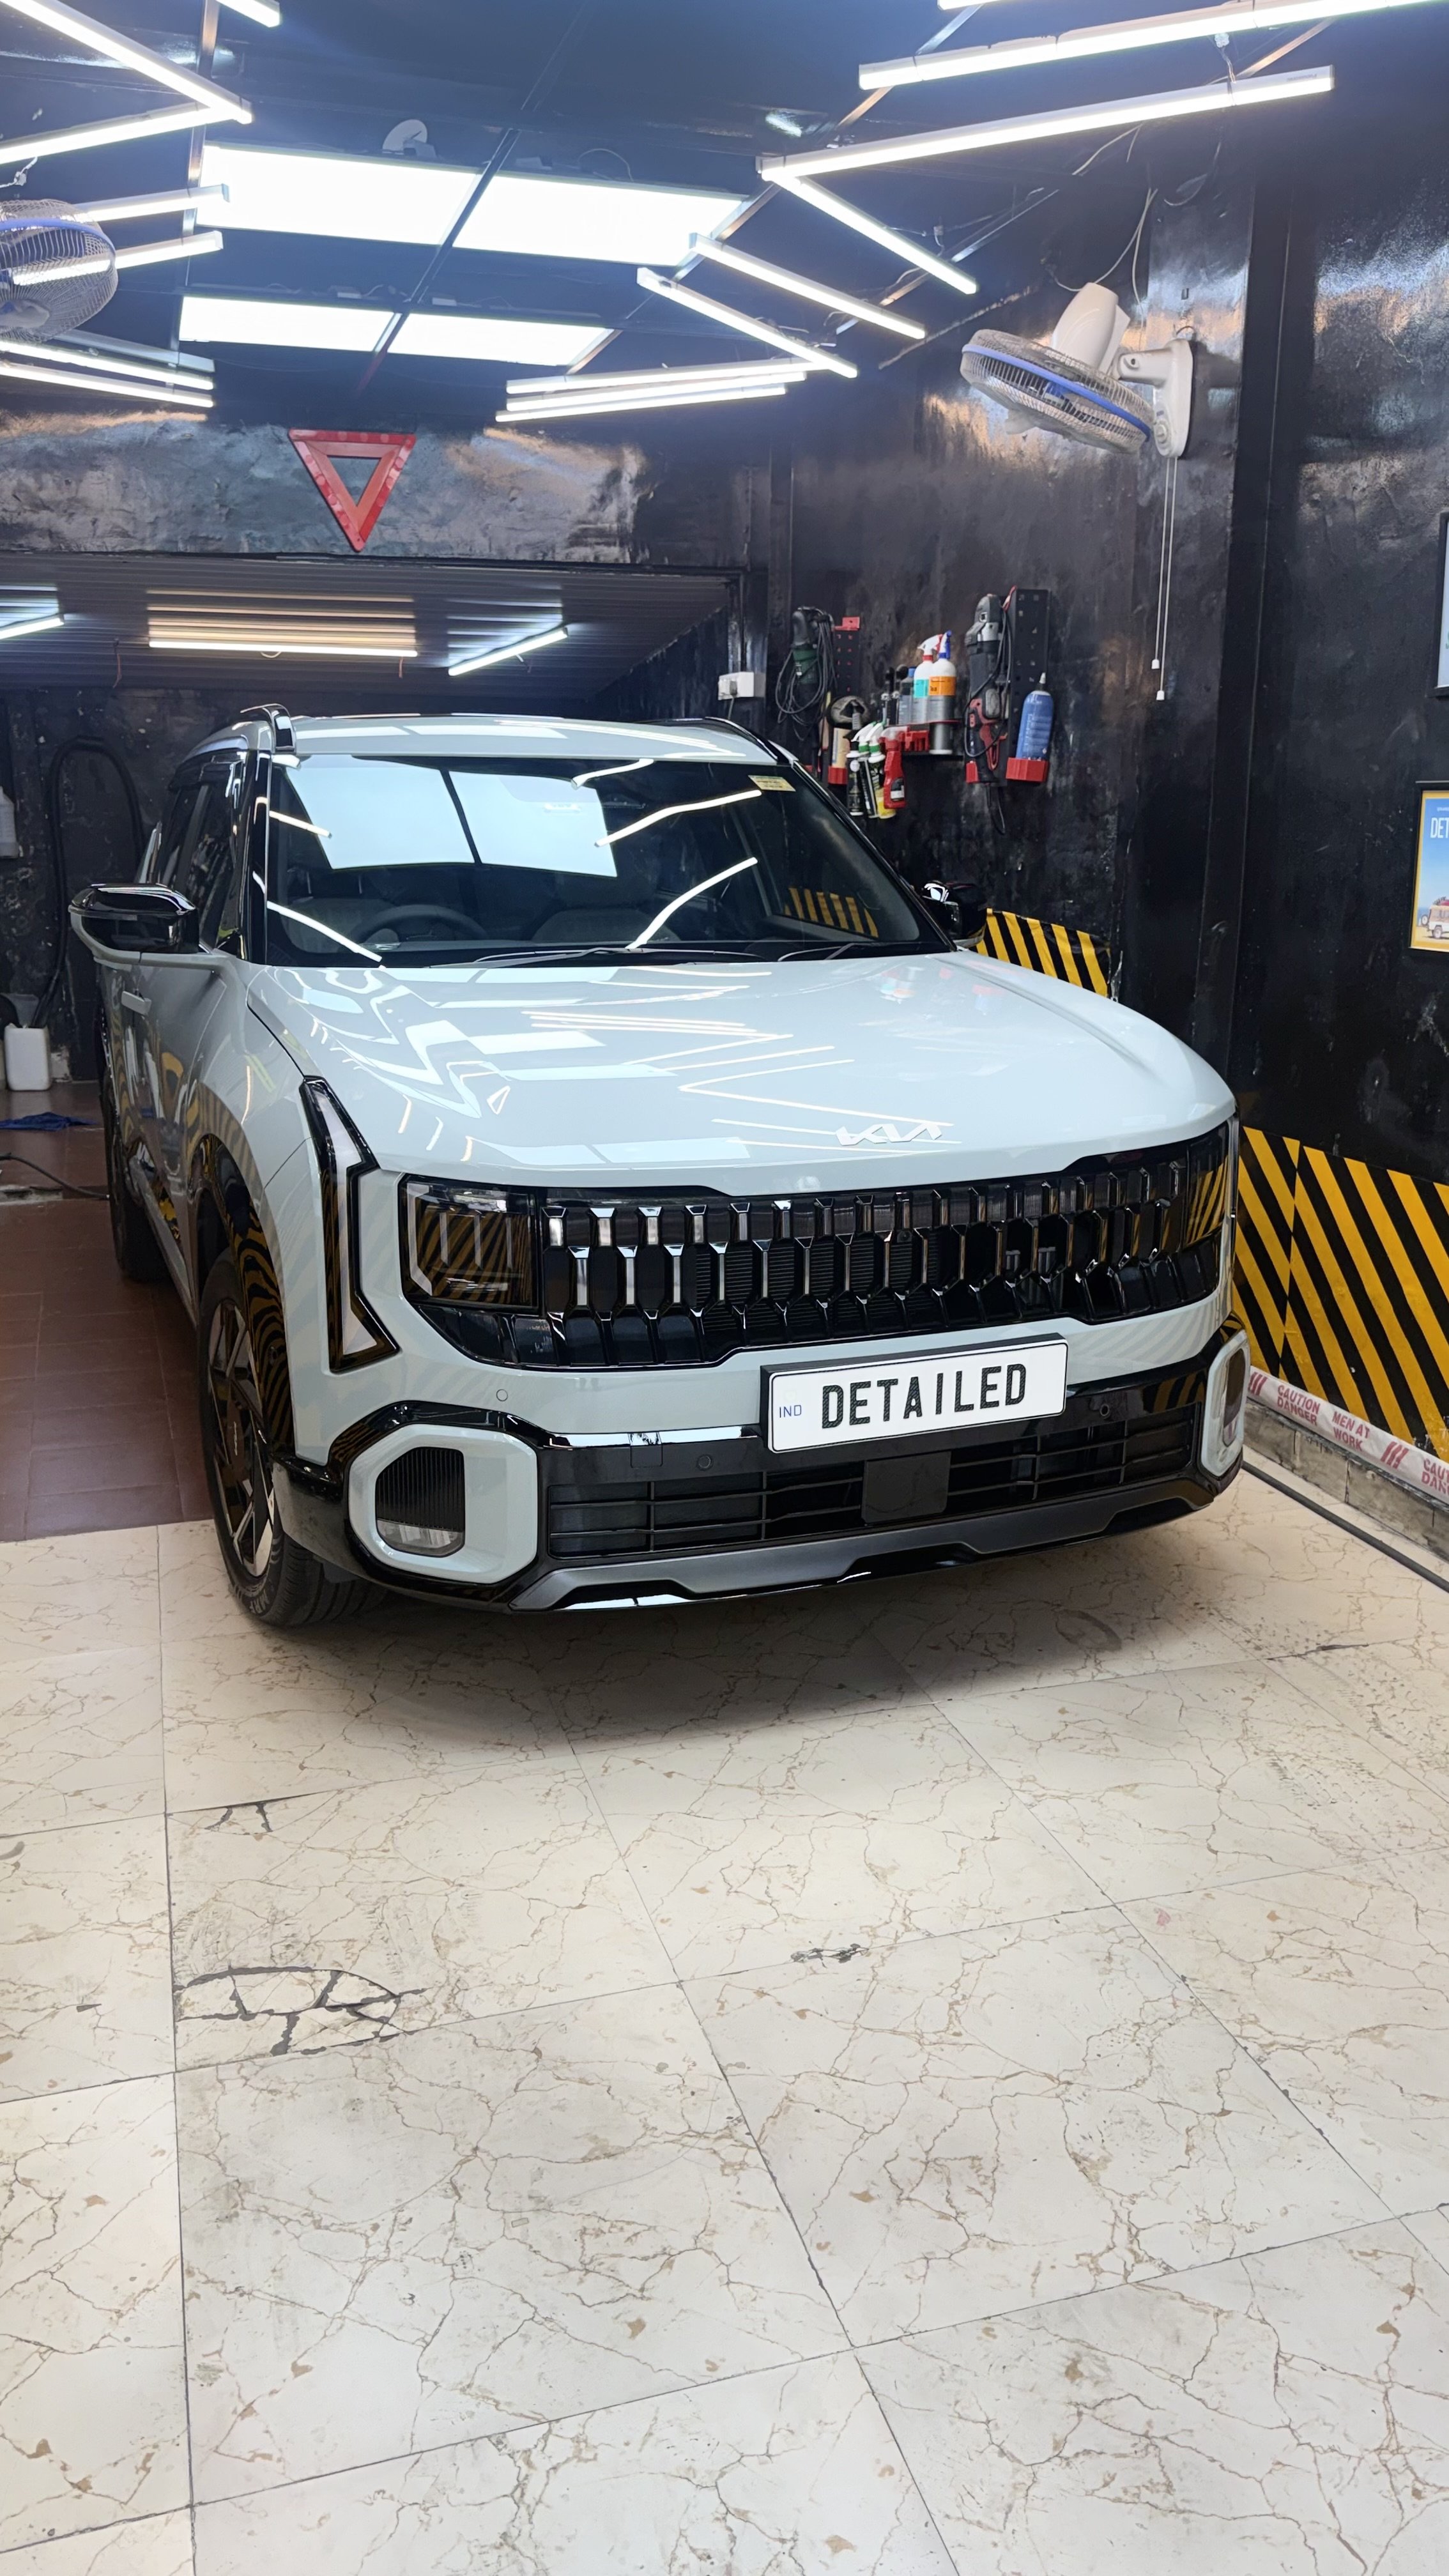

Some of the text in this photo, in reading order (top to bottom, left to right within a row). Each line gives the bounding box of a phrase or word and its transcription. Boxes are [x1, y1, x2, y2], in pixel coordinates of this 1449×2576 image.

[836, 1122, 942, 1146] KIA
[822, 1363, 1027, 1429] DETAILED
[1278, 1385, 1321, 1414] CAUTION
[779, 1405, 802, 1418] IND
[1277, 1397, 1317, 1426] DANGER
[1332, 1411, 1370, 1439] MEN AT
[1333, 1427, 1363, 1452] WORK
